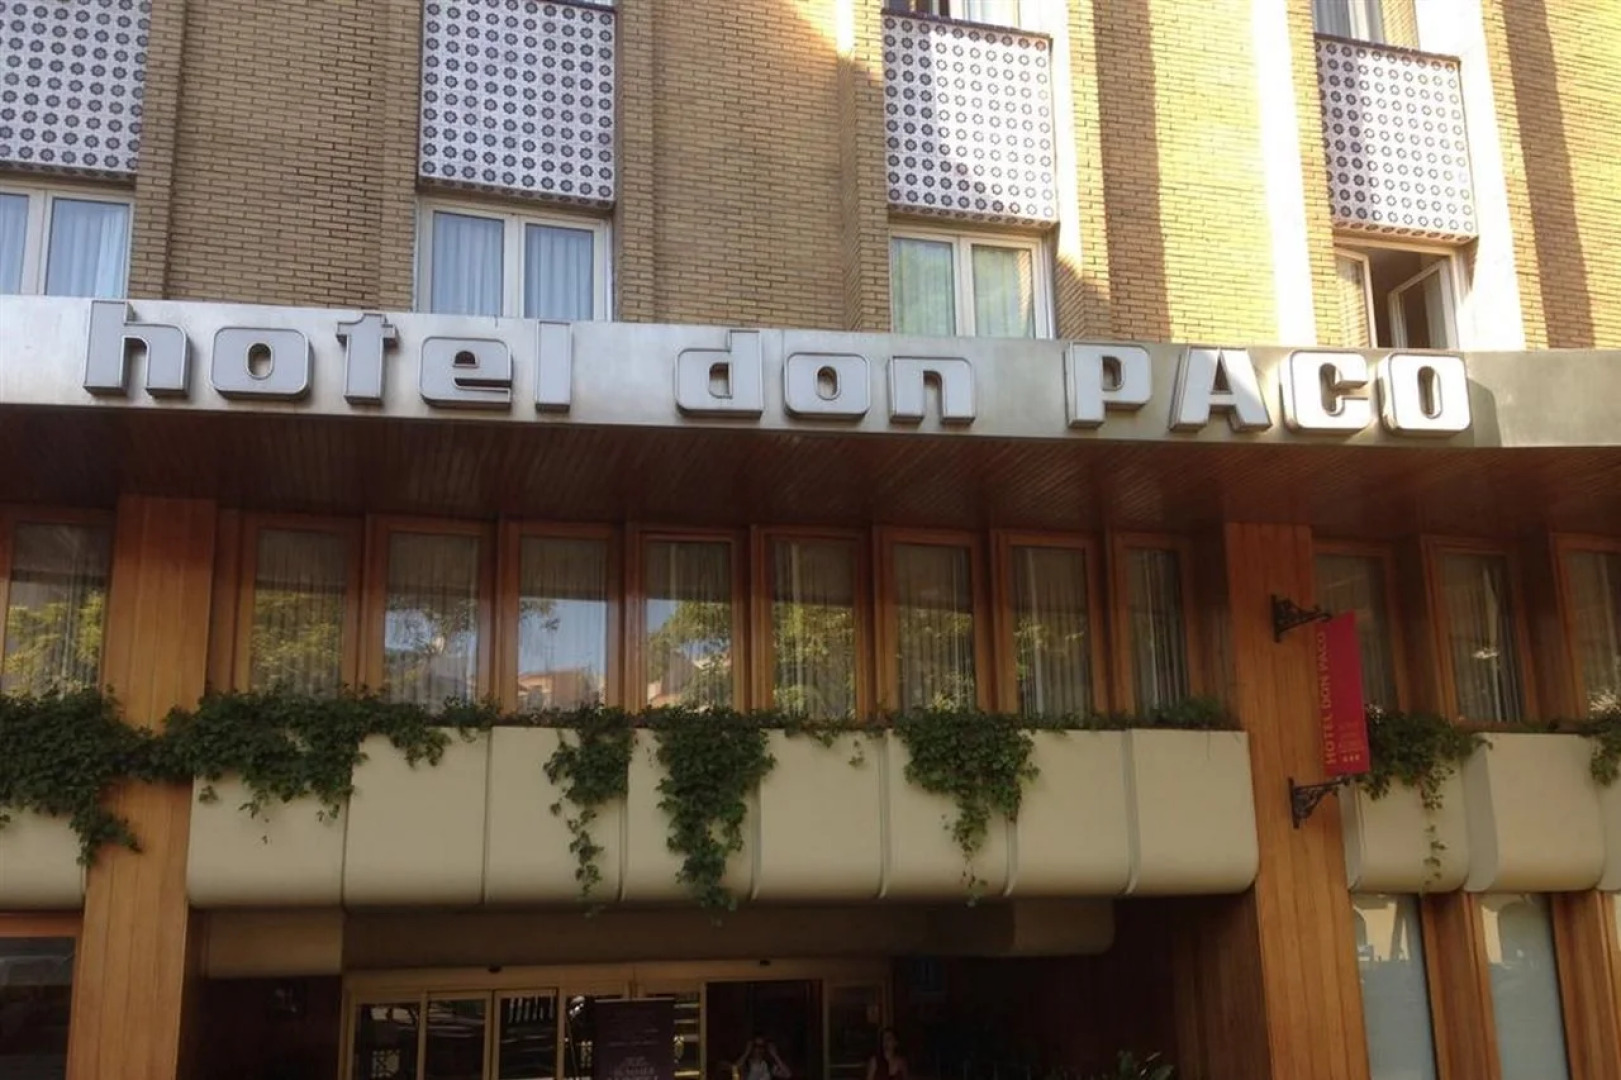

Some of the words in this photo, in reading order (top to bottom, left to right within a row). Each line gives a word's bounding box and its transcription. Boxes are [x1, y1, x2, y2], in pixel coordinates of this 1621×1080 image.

[84, 299, 572, 412] hotel
[675, 329, 976, 425] don
[1065, 341, 1472, 436] PACO
[1316, 631, 1329, 672] PACO
[1319, 676, 1332, 709] DON
[1322, 712, 1337, 765] HOTEL
